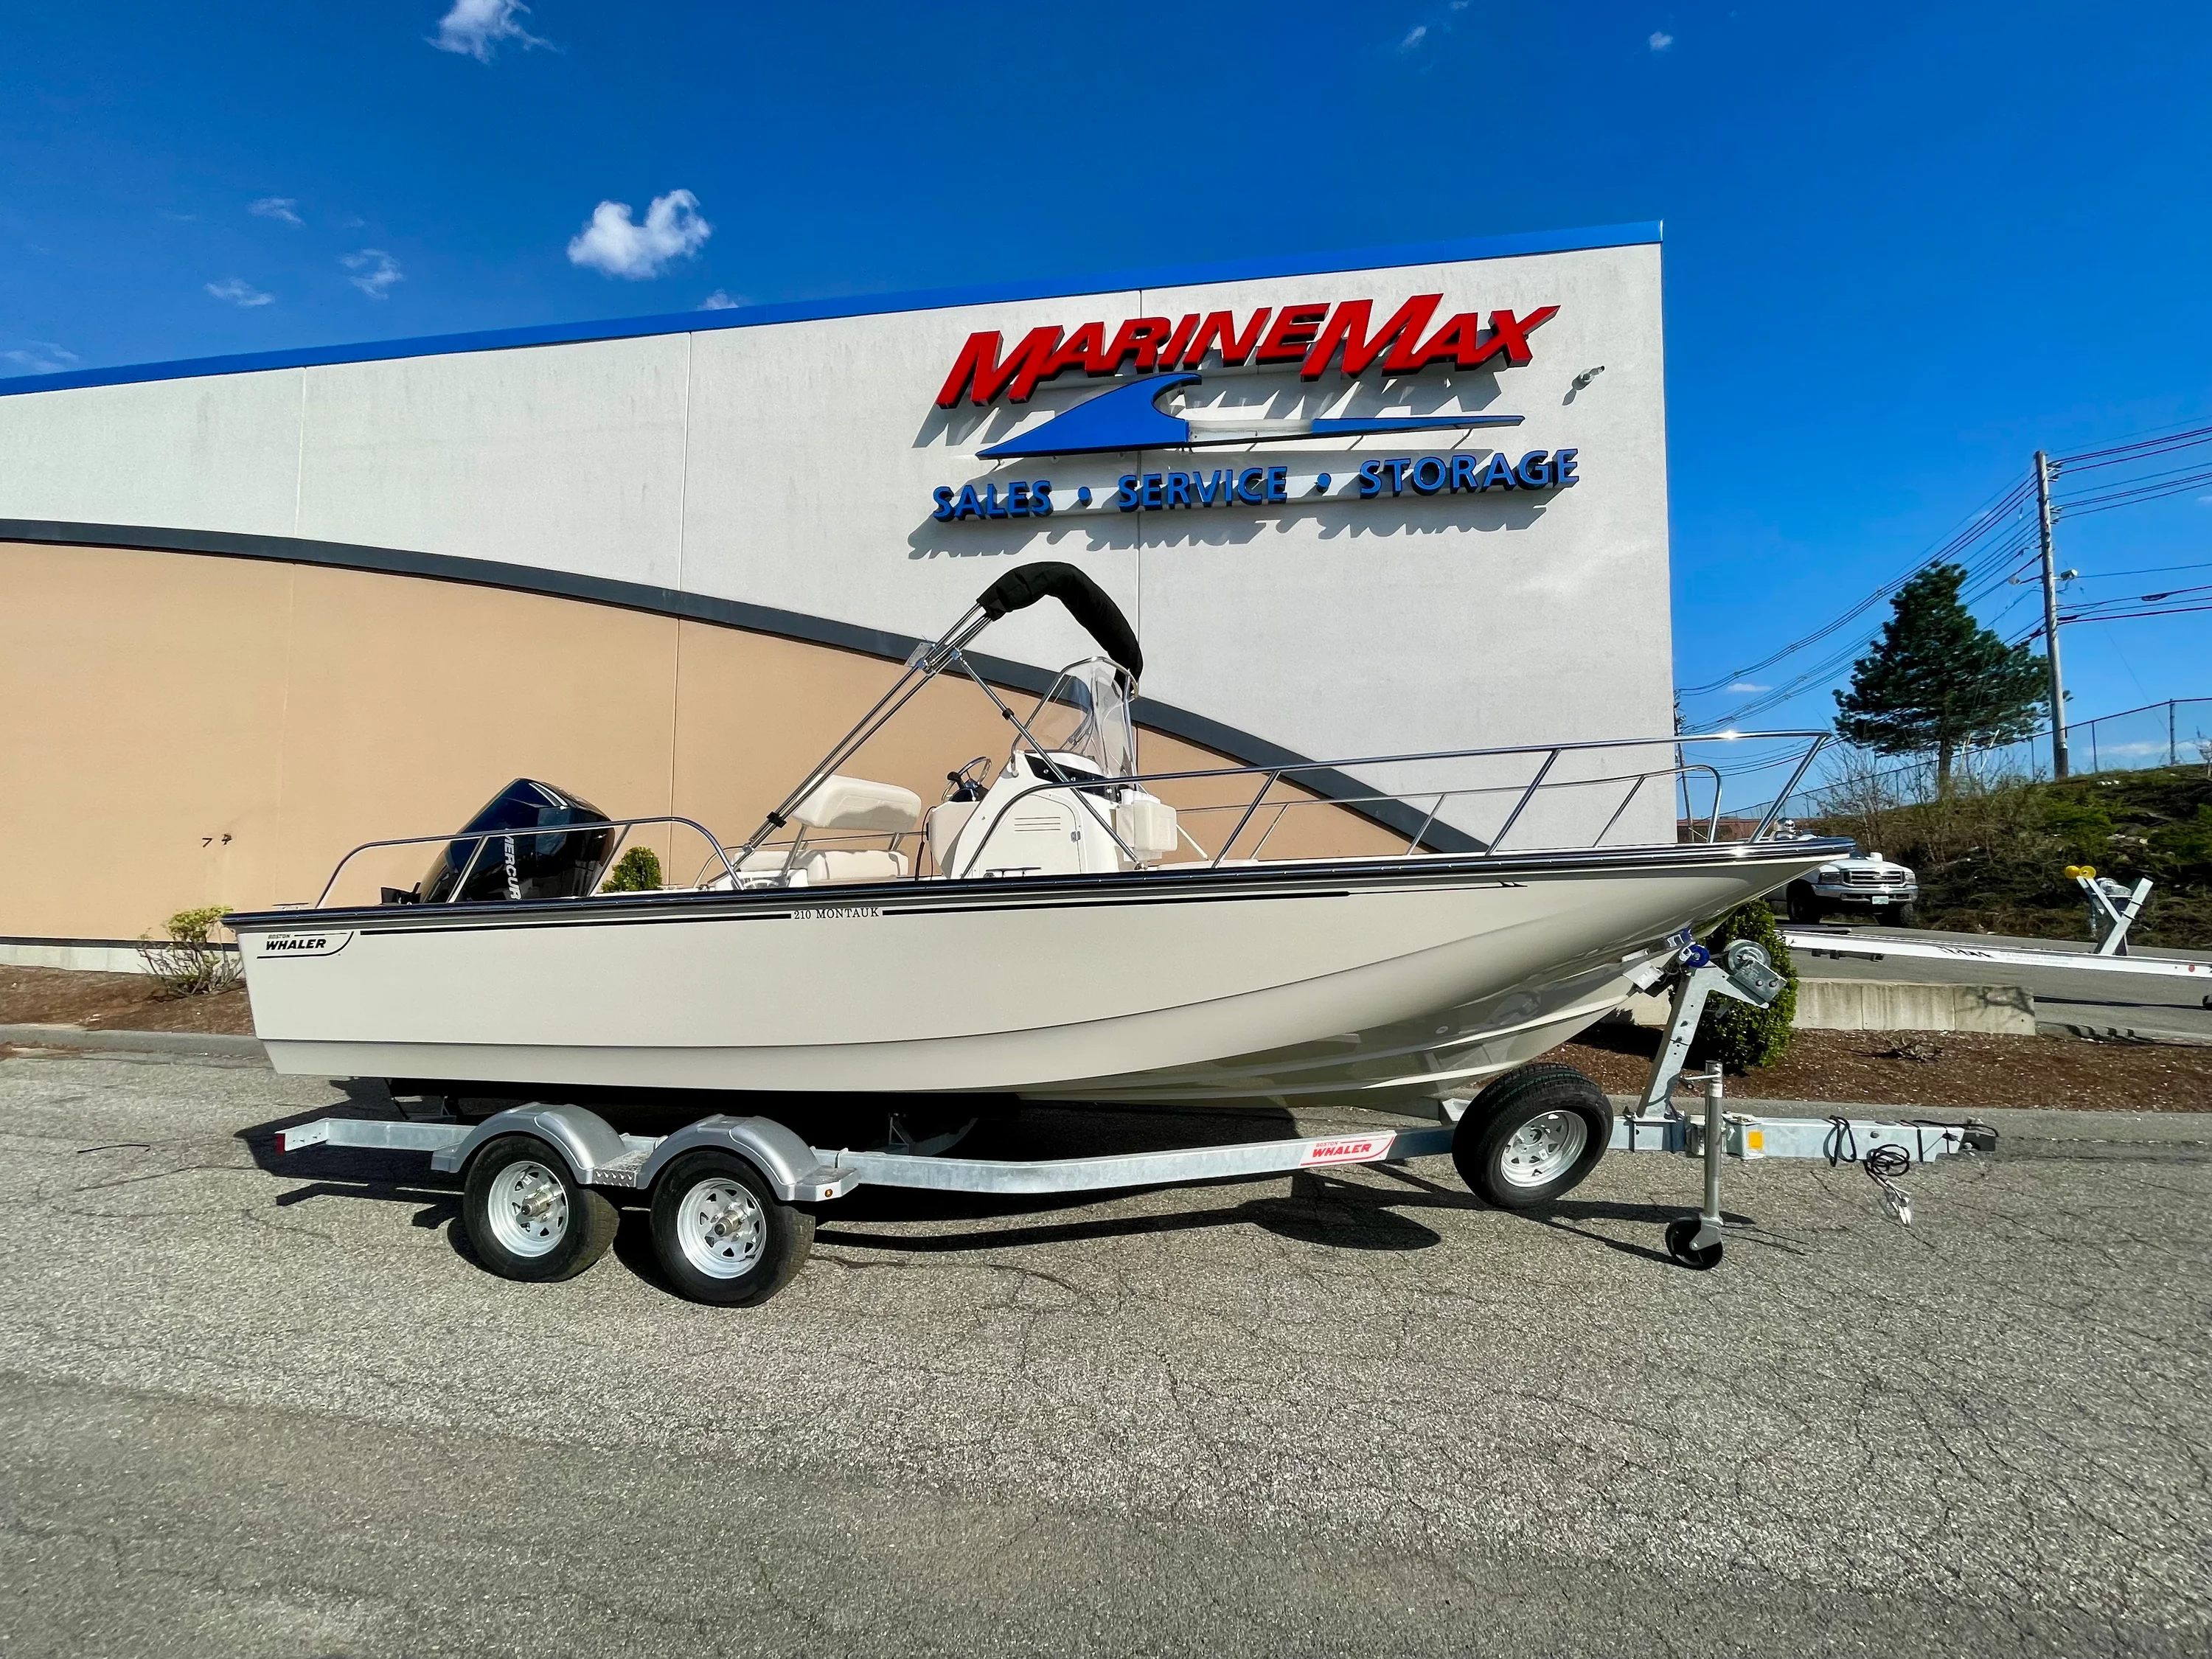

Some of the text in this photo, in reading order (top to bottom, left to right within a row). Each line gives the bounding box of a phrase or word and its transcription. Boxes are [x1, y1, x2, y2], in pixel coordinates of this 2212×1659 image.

[932, 448, 1580, 523] SALES SERVICE STORAGE
[504, 828, 522, 900] MERCUR
[794, 908, 880, 919] 210 MONTAUK
[265, 939, 327, 950] WHALER
[1312, 1143, 1372, 1158] WHALER
